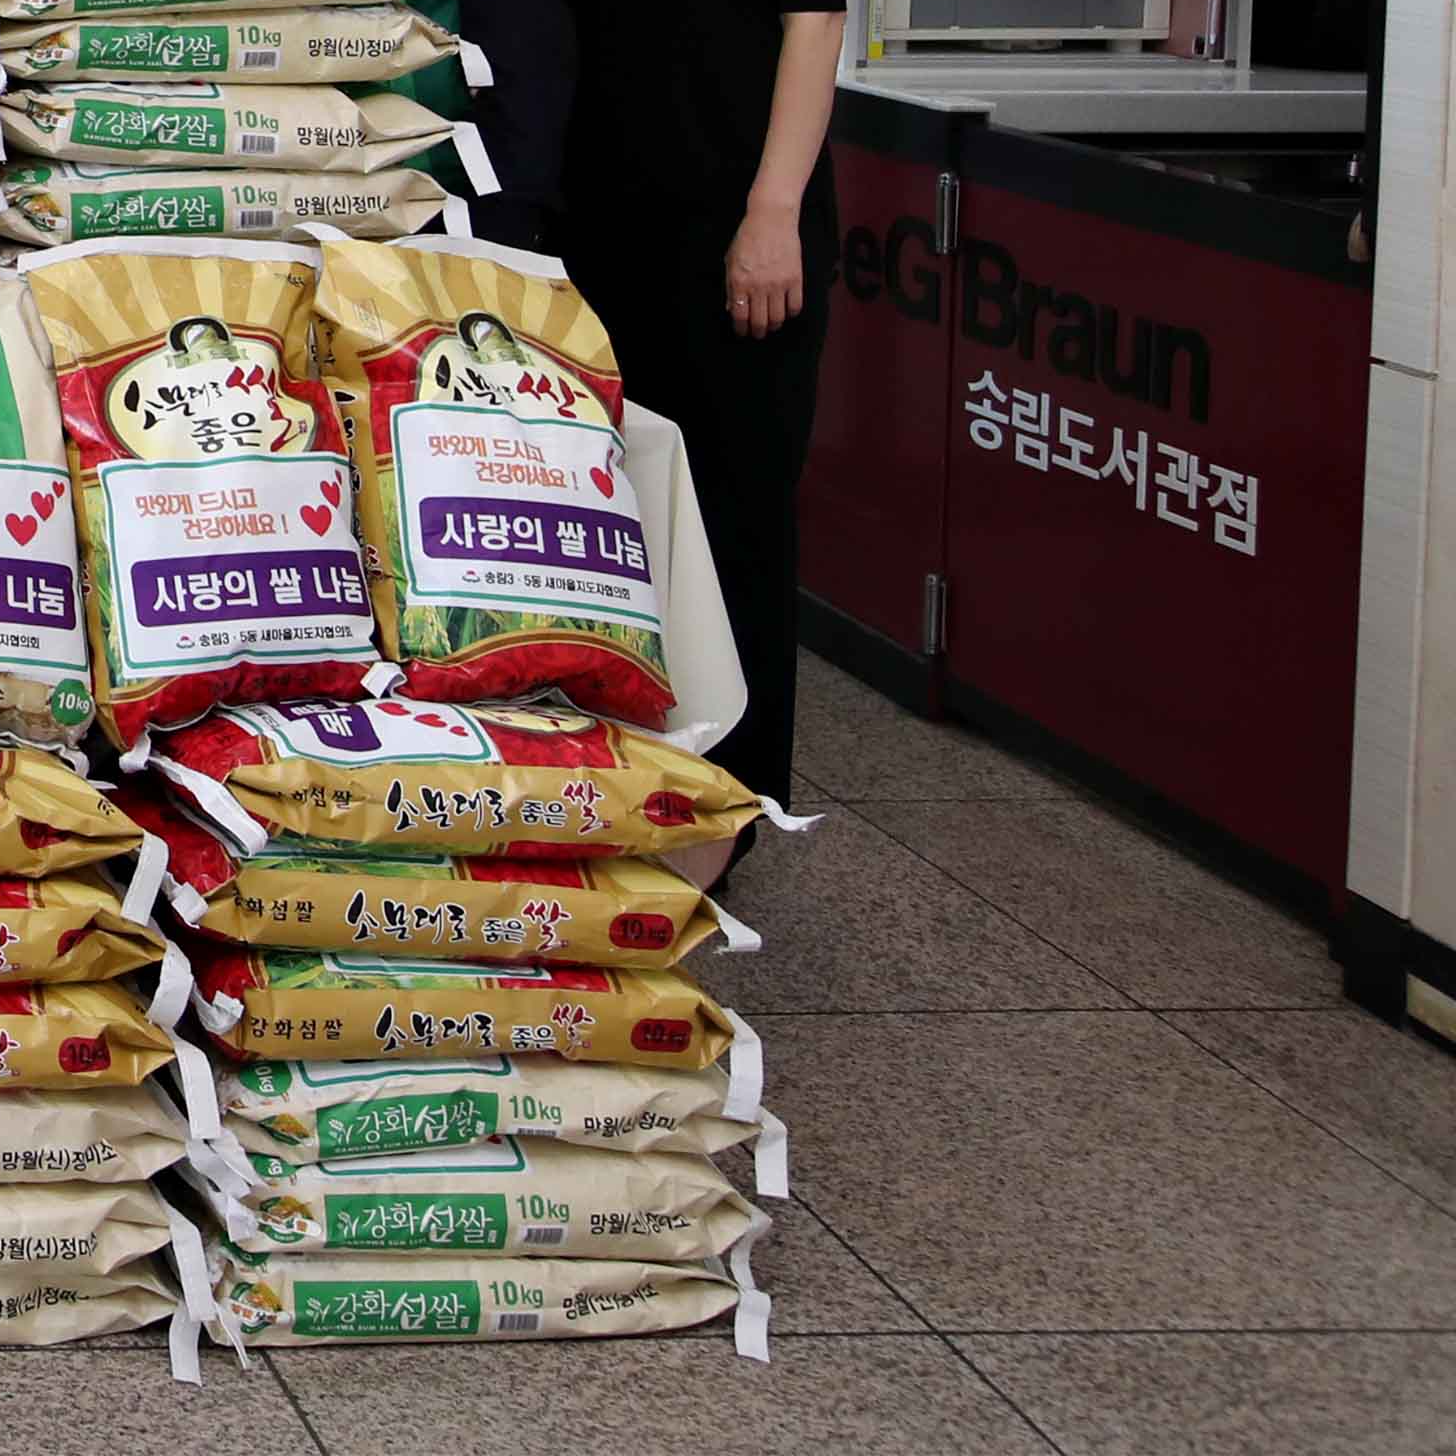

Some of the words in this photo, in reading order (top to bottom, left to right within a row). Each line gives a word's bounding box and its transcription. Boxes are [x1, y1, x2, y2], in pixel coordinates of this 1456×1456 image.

[961, 237, 1213, 424] Braun
[965, 370, 1258, 557] 송림도서관점
[439, 510, 546, 555] 사랑의
[556, 519, 589, 561] 쌀
[598, 525, 647, 572] 나눔
[5, 574, 67, 618] 나눔
[151, 570, 258, 615] 사랑의
[268, 567, 305, 608] 쌀
[314, 566, 366, 607] 나눔
[56, 692, 91, 715] 10kg
[482, 915, 525, 943] 좋은
[522, 898, 573, 952] 쌀
